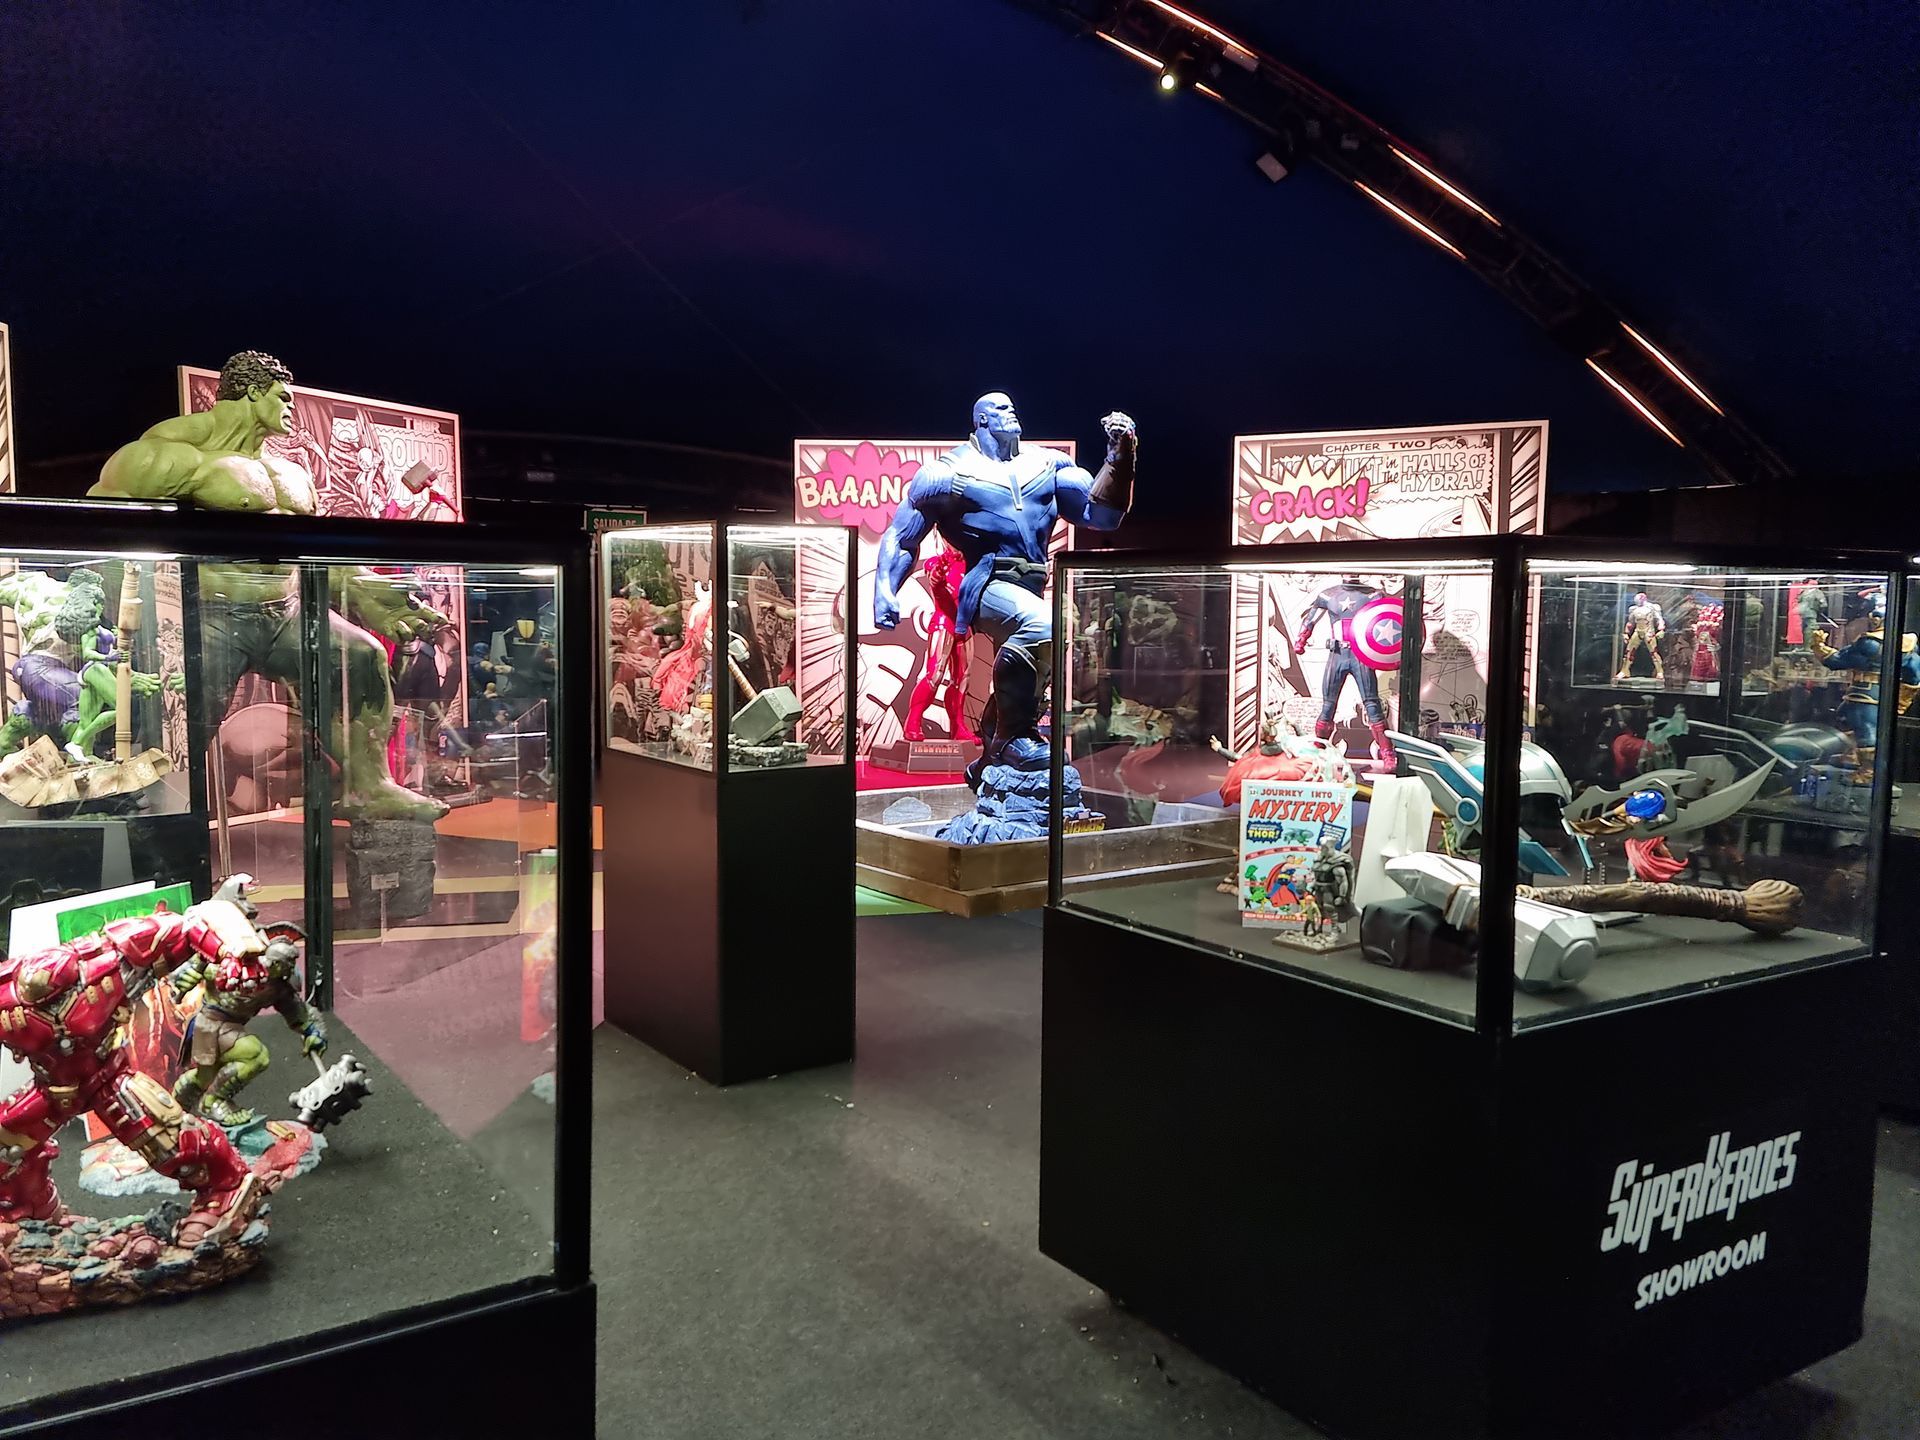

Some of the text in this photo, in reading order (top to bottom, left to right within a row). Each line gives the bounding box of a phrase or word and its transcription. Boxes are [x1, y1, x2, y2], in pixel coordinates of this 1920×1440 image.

[402, 416, 442, 434] THOR
[1325, 440, 1426, 453] CHAPTER TWO
[1386, 456, 1398, 469] in
[1402, 452, 1466, 473] HALLS
[1400, 469, 1484, 493] HYDRA!
[1250, 477, 1370, 525] CRACK!
[1261, 789, 1303, 797] JOURNEY
[1311, 791, 1333, 799] INTO
[1248, 799, 1343, 823] MYSTERY
[1248, 829, 1280, 839] THOR!
[1634, 1231, 1767, 1310] SHOWROOM
